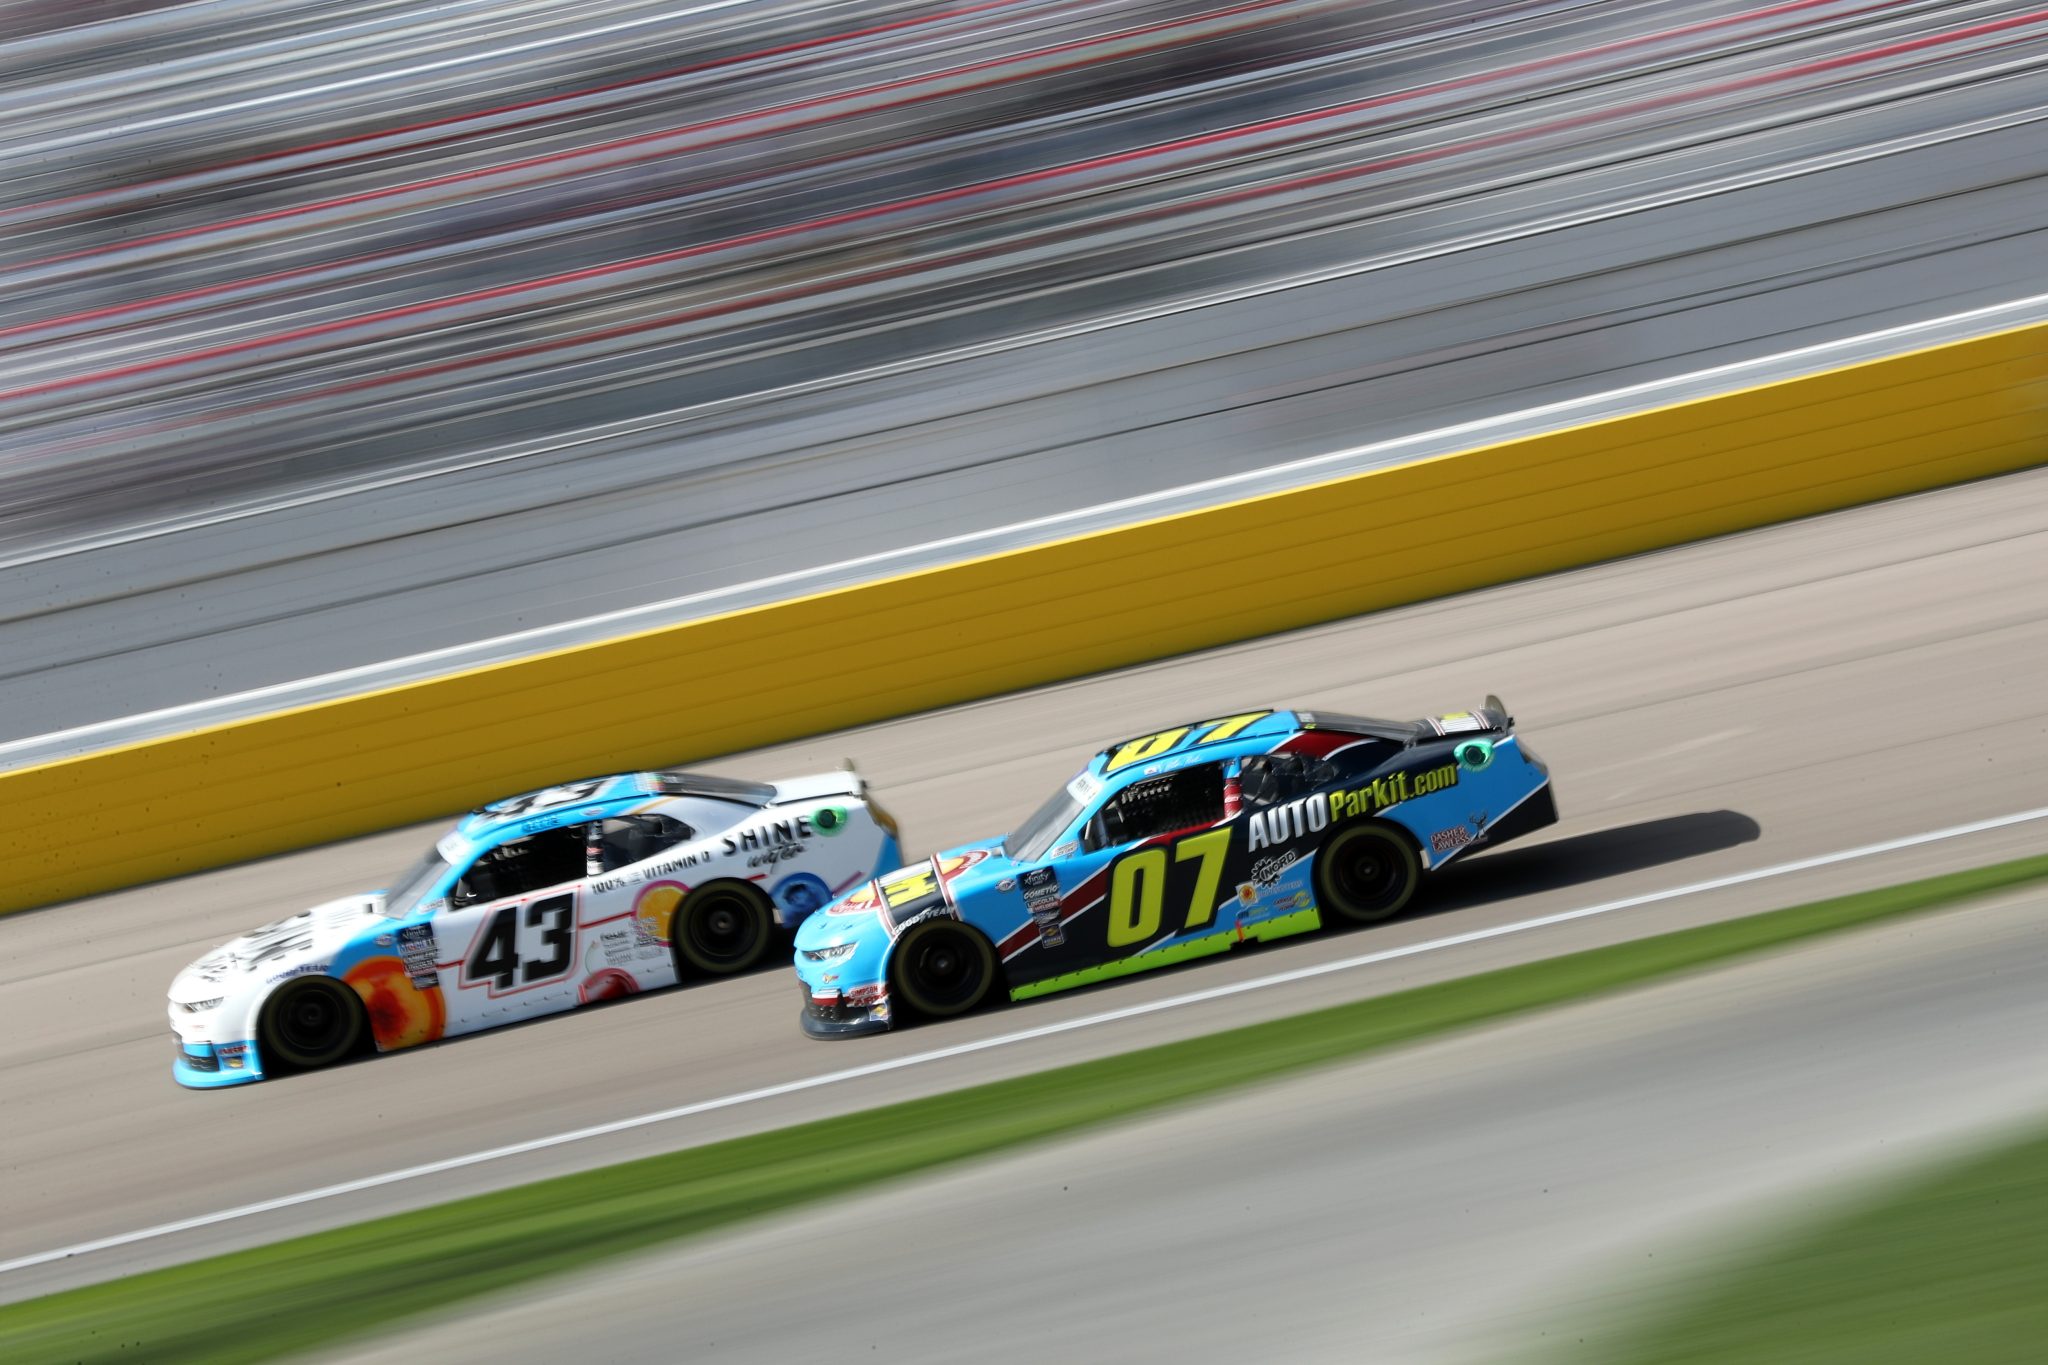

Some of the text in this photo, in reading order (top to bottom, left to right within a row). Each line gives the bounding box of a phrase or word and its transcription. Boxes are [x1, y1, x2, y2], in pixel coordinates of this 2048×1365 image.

[721, 815, 812, 857] SHINE
[1430, 825, 1466, 843] DASHER
[591, 876, 625, 895] 100%
[642, 853, 698, 880] VITAMIN
[1024, 872, 1050, 886] xfinity
[1263, 851, 1296, 879] NORD
[1107, 826, 1231, 947] 07
[1027, 896, 1055, 909] LINCOLN
[467, 892, 574, 990] 43
[850, 984, 879, 998] SIMPSON
